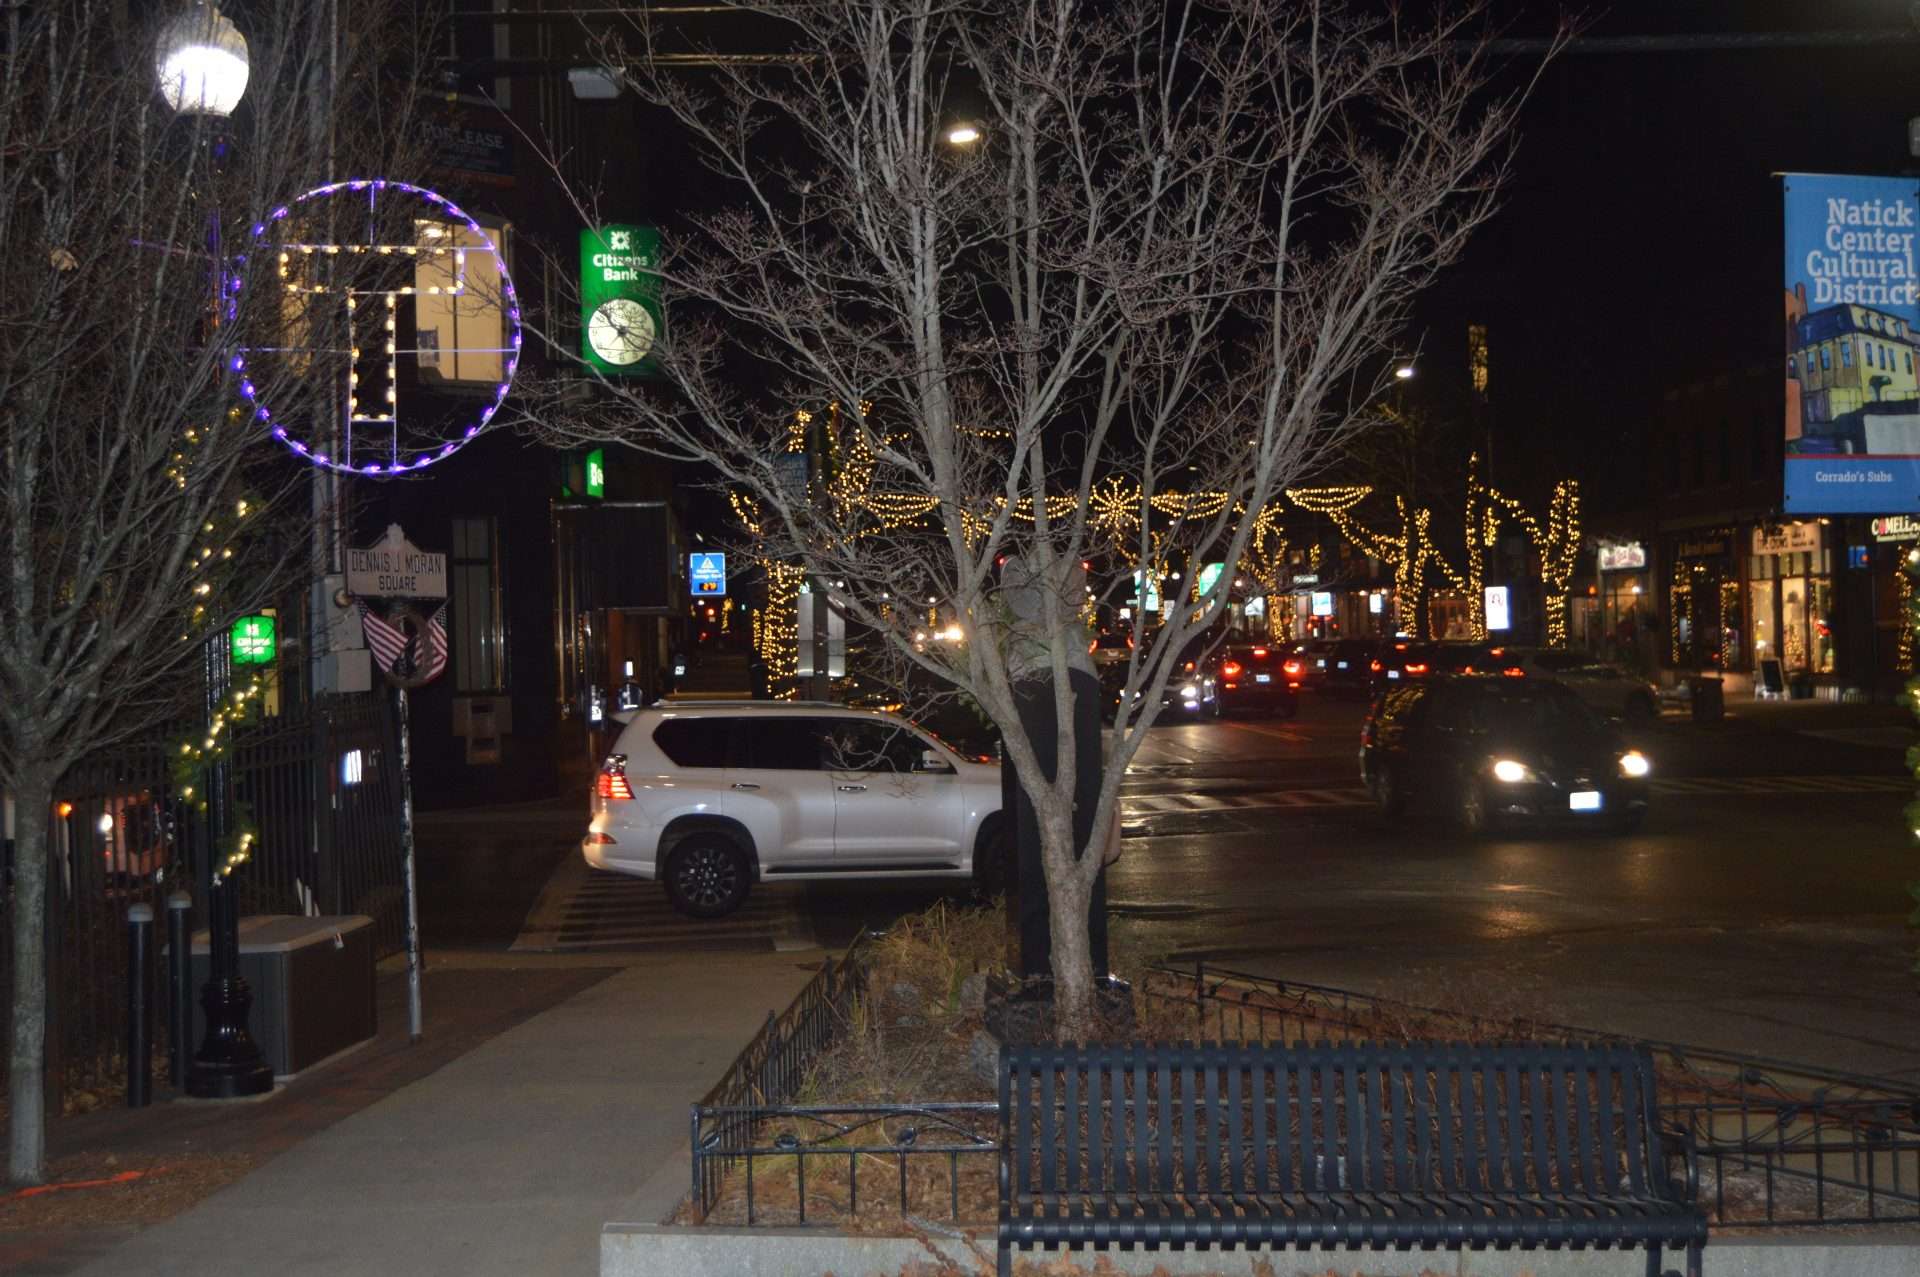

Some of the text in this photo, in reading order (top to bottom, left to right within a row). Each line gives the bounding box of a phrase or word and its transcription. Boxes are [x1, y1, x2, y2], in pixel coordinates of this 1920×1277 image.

[1826, 198, 1914, 227] Natick
[1825, 224, 1914, 253] Center
[592, 253, 648, 268] Citizens
[1806, 249, 1916, 279] Cultural
[603, 267, 638, 281] Bank
[1813, 276, 1917, 305] District
[1815, 471, 1893, 483] Corrado's Subs
[351, 551, 441, 576] DENNIS J MORAN
[378, 575, 417, 592] SQUARE
